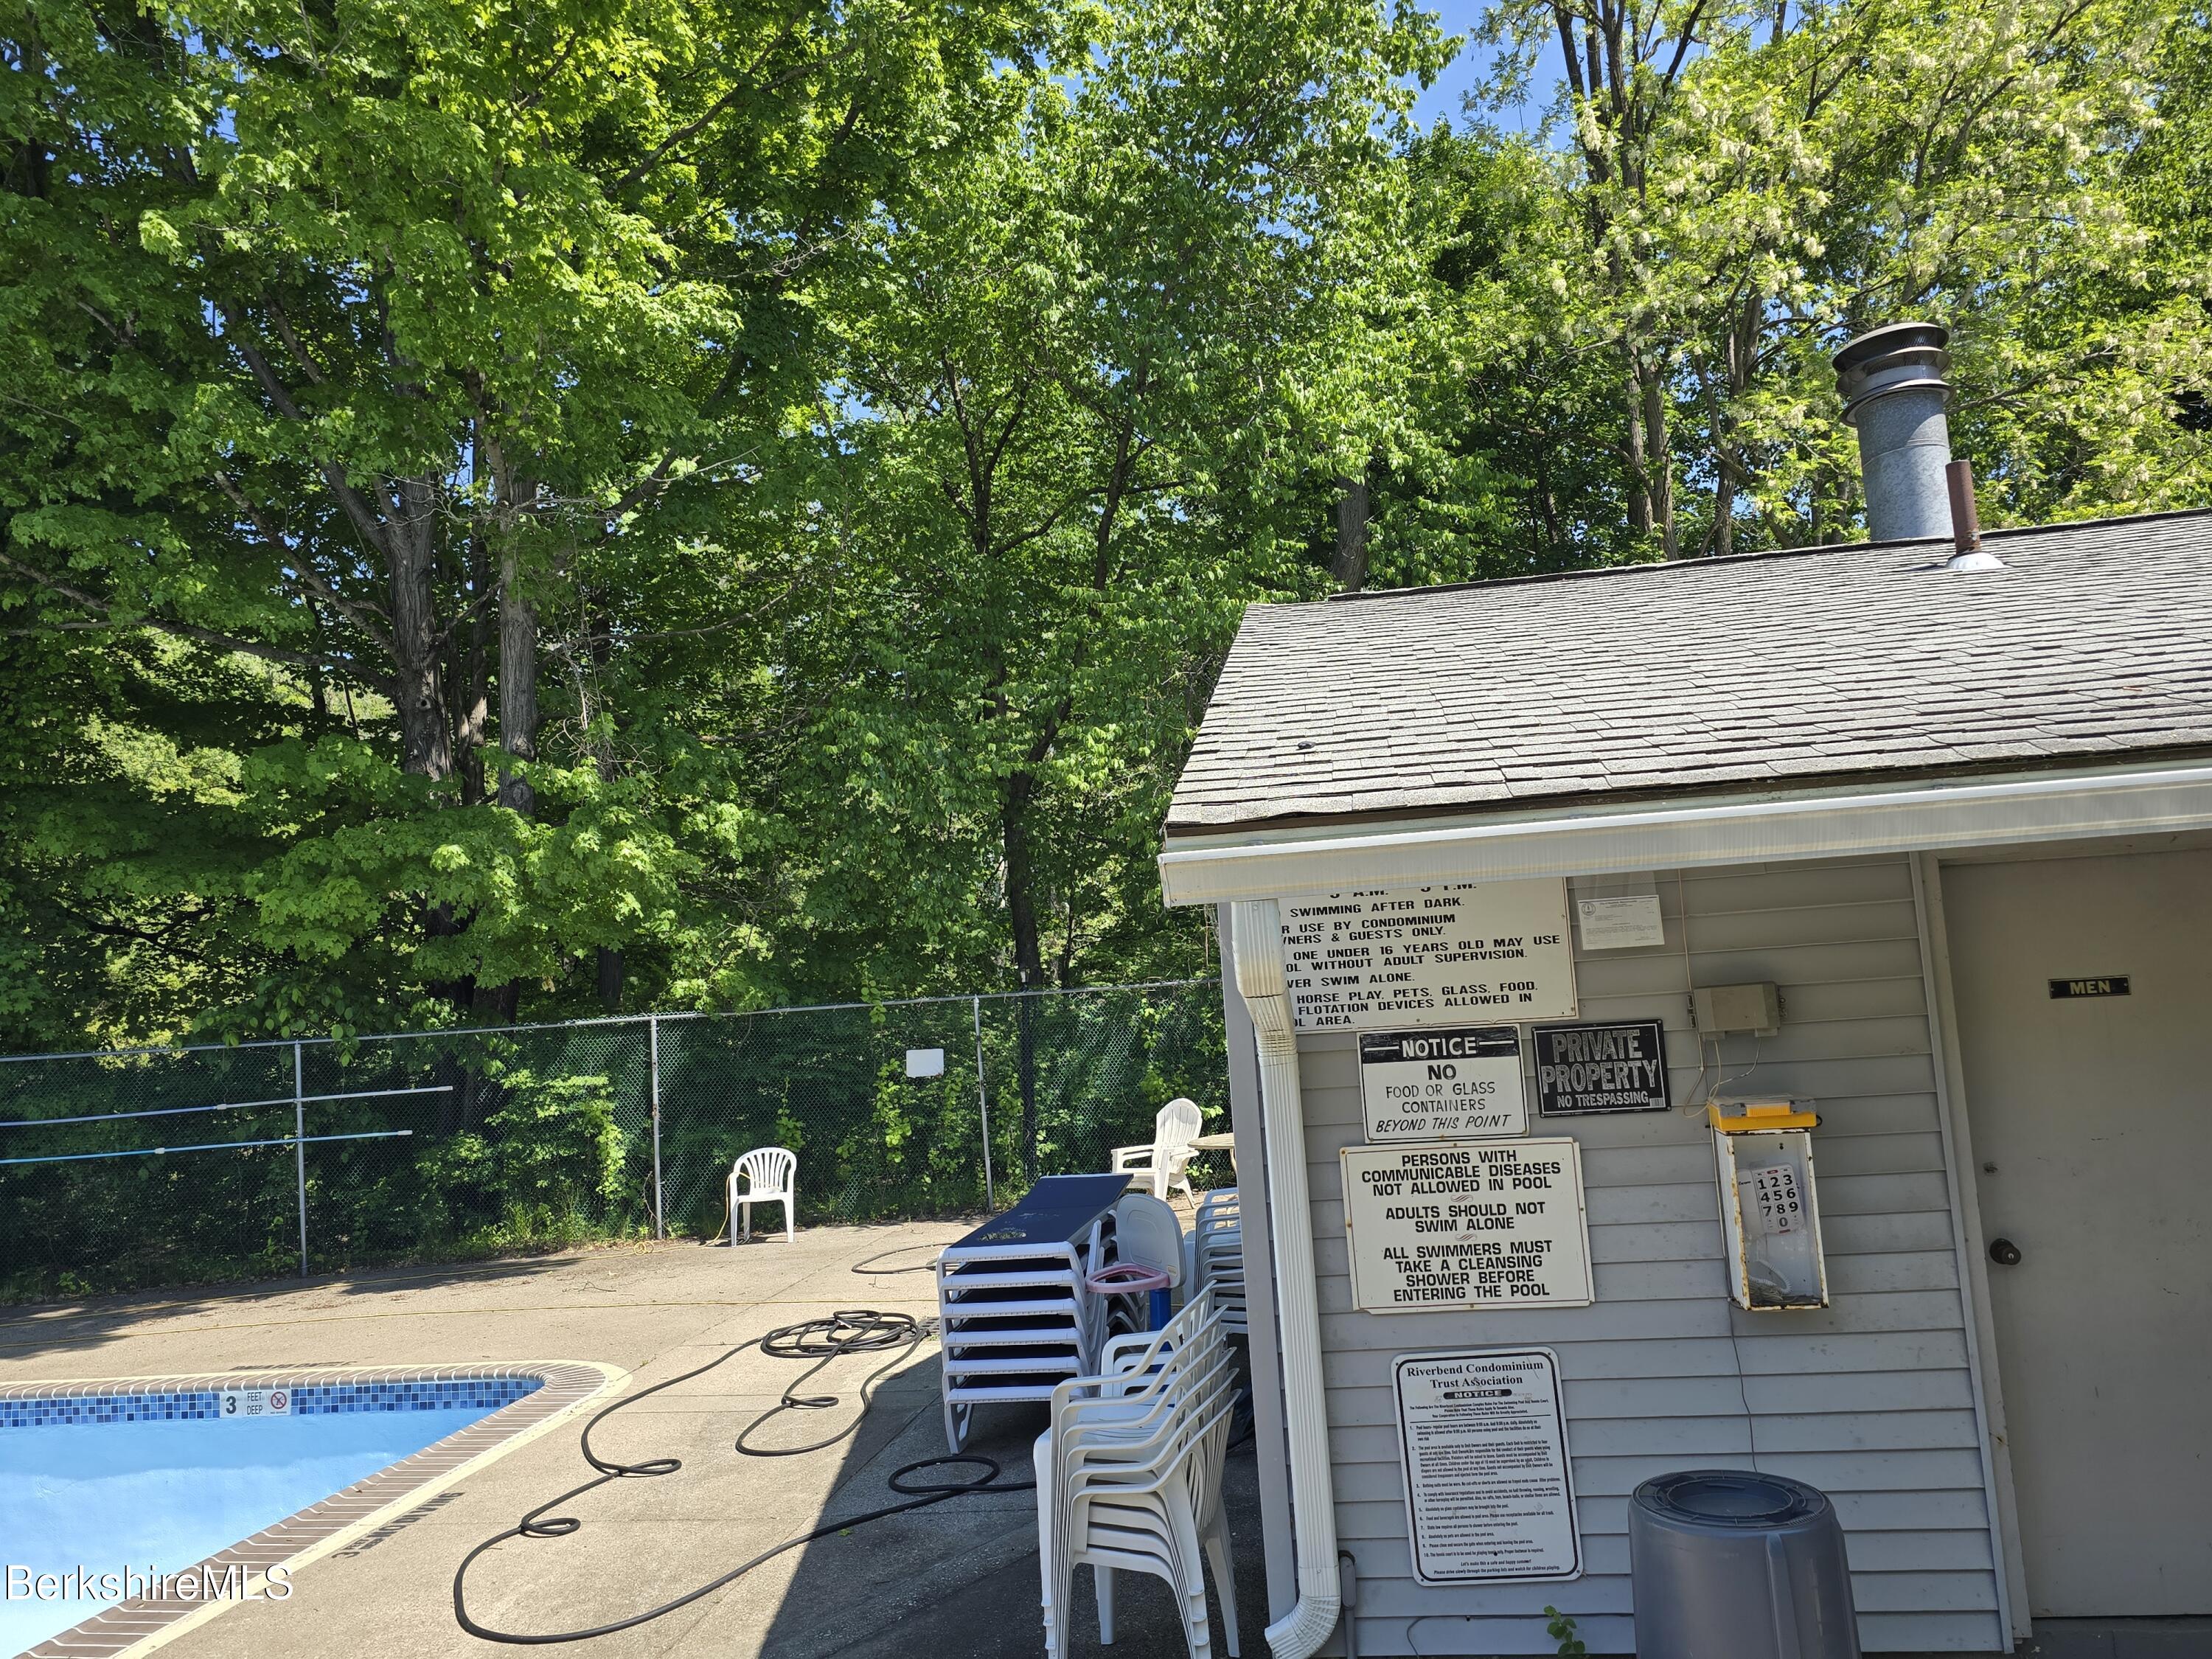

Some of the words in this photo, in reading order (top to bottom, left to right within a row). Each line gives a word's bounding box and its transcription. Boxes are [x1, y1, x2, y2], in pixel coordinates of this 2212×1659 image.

[1290, 904, 1362, 917] SWIMMING
[1371, 900, 1415, 911] AFTER
[1424, 897, 1464, 908] DARK.
[1299, 923, 1325, 933] USE
[1333, 920, 1352, 931] BY
[1361, 914, 1455, 929] CONDOMINIUM
[1331, 933, 1340, 942] &
[1349, 928, 1402, 941] GUESTS
[1412, 925, 1446, 936] ONLY.
[1293, 950, 1318, 961] ONE
[1326, 947, 1370, 959] UNDER
[1380, 945, 1394, 955] 16
[1402, 942, 1449, 953] YEARS
[1458, 939, 1484, 950] OLD
[1493, 937, 1523, 947] MAY
[1533, 935, 1560, 945] USE
[1310, 958, 1374, 970] WITHOUT
[1383, 955, 1425, 966] ADULT
[1434, 949, 1528, 964] SUPERVISION.
[1321, 975, 1360, 987] SWIM
[1369, 973, 1415, 984] ALONE.
[2069, 980, 2111, 995] MEN
[1296, 993, 1340, 1004] HORSE
[1298, 1003, 1369, 1016] FLOTATION
[1377, 999, 1435, 1011] DEVICES
[1444, 994, 1510, 1007] ALLOWED
[1519, 993, 1532, 1002] IN
[1315, 1015, 1355, 1026] AREA.
[1402, 1037, 1477, 1059] NOTICE
[1551, 1029, 1644, 1063] PRIVATE
[1427, 1064, 1457, 1081] NO
[1541, 1059, 1658, 1093] PROPERTY
[1385, 1085, 1419, 1099] FOOD
[1425, 1084, 1443, 1096] OR
[1452, 1081, 1495, 1096] GLASS
[1402, 1098, 1486, 1113] CONTAINERS
[1557, 1094, 1573, 1107] NO
[1575, 1091, 1649, 1107] TRESPASSING
[1375, 1119, 1426, 1133] BEYOND
[1432, 1116, 1460, 1130] THIS
[1465, 1114, 1512, 1129] POINT
[1402, 1152, 1471, 1167] PERSONS
[1478, 1150, 1517, 1163] WITH
[1361, 1165, 1481, 1183] COMMUNICABLE
[1488, 1161, 1561, 1177] DISEASES
[1373, 1183, 1402, 1197] NOT
[1411, 1180, 1480, 1194] ALLOWED
[1488, 1179, 1504, 1191] IN
[1512, 1177, 1552, 1190] POOL
[1758, 1179, 1767, 1189] 1
[1770, 1177, 1780, 1187] 2
[1783, 1175, 1792, 1185] 3
[1761, 1192, 1770, 1202] 4
[1773, 1190, 1782, 1200] 5
[1787, 1188, 1795, 1198] 6
[1385, 1206, 1440, 1220] ADULTS
[1448, 1203, 1507, 1217] SHOULD
[1515, 1201, 1545, 1215] NOT
[1763, 1206, 1771, 1217] 7
[1776, 1204, 1785, 1214] 8
[1789, 1202, 1798, 1212] 9
[1415, 1219, 1458, 1233] SWIM
[1466, 1217, 1515, 1231] ALONE
[1779, 1217, 1787, 1227] 0
[1383, 1247, 1409, 1260] ALL
[1416, 1242, 1502, 1259] SWIMMERS
[1509, 1239, 1553, 1254] MUST
[1395, 1259, 1432, 1273] TAKE
[1440, 1259, 1451, 1271] A
[1458, 1254, 1543, 1270] CLEANSING
[1405, 1273, 1470, 1287] SHOWER
[1478, 1269, 1535, 1284] BEFORE
[1394, 1287, 1466, 1301] ENTERING
[1473, 1285, 1502, 1298] THE
[1510, 1284, 1551, 1297] POOL
[1407, 1365, 1463, 1377] Riverbend
[1466, 1361, 1544, 1373] Condominium
[1429, 1380, 1458, 1388] Trust
[1461, 1375, 1523, 1387] Association
[247, 1391, 262, 1402] FEET
[1453, 1389, 1502, 1399] NOTICE
[226, 1395, 237, 1414] 3
[247, 1405, 262, 1415] DEEP
[391, 1492, 465, 1523] DIVING
